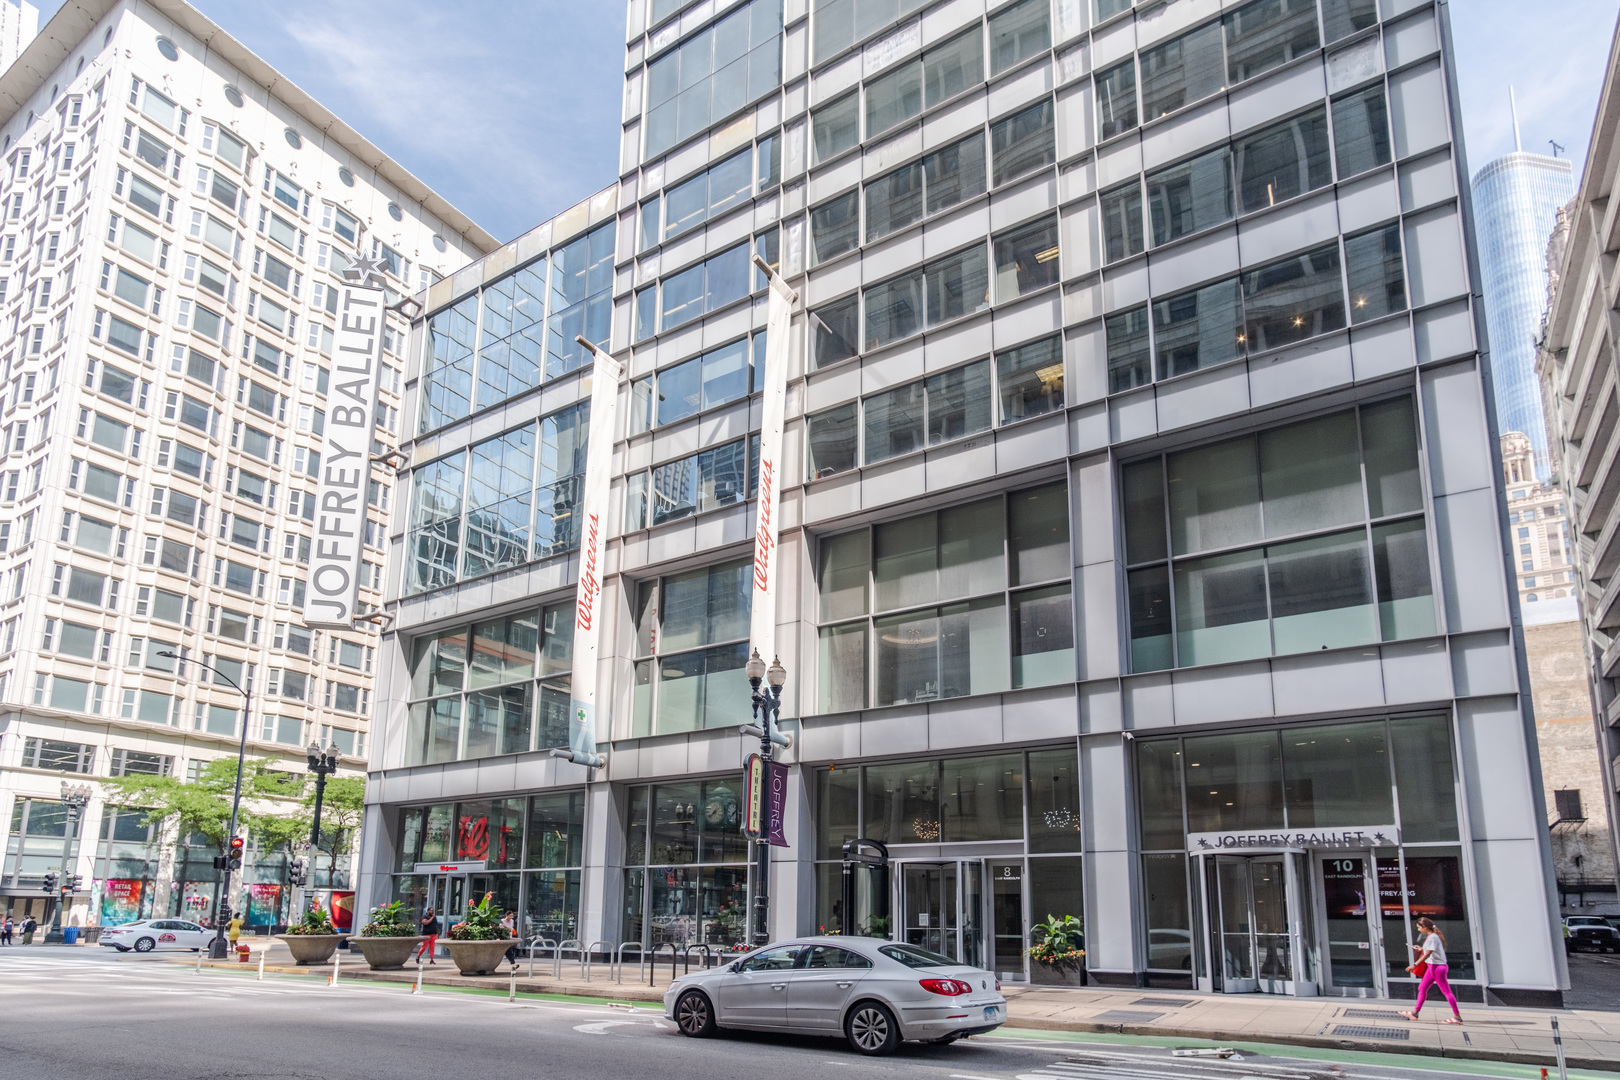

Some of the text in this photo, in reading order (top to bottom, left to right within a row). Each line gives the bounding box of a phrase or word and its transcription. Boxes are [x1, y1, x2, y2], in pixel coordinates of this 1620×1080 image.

[311, 290, 377, 619] JOFFREY BALLET
[754, 459, 774, 592] Walgreens
[577, 512, 599, 631] Walgreens
[771, 769, 782, 838] JOFFREY
[1003, 866, 1011, 877] 8
[1215, 831, 1364, 848] JOFFREY BALLET
[1332, 860, 1353, 872] 10
